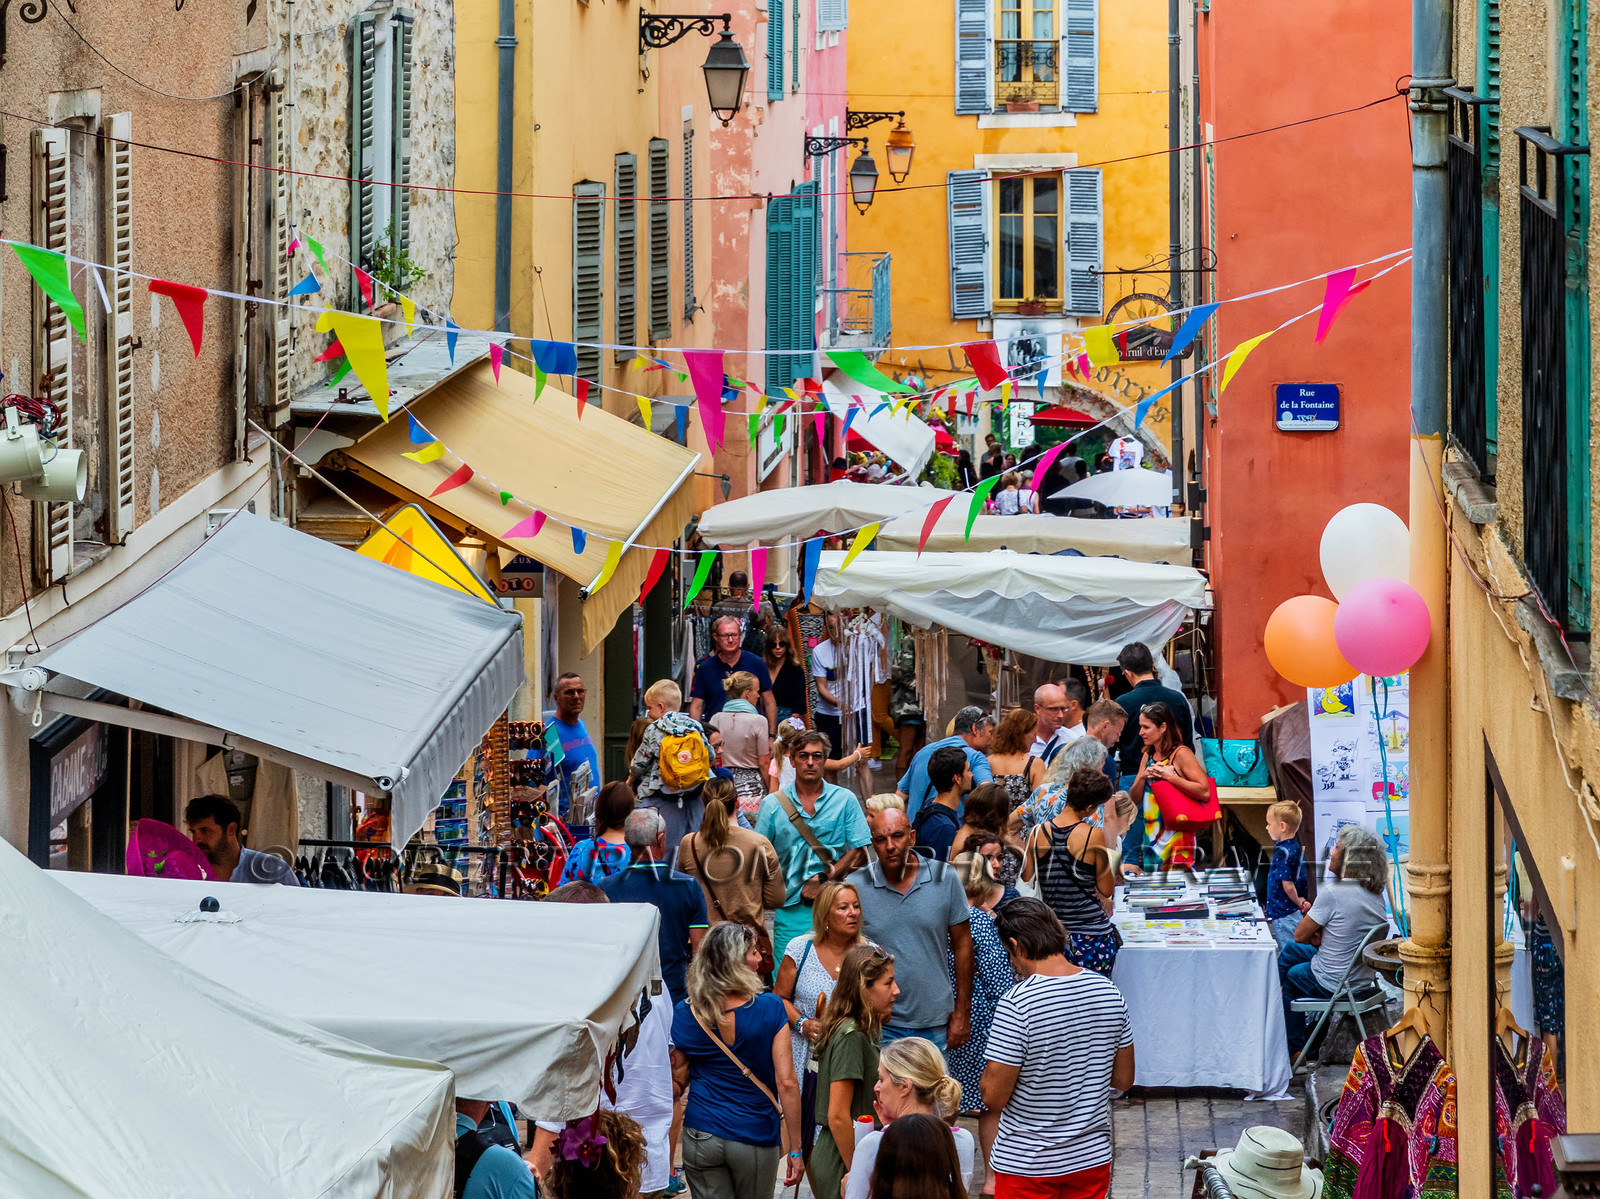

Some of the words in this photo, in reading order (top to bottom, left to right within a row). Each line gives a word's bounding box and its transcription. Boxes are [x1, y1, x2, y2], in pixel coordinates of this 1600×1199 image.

[1299, 388, 1316, 397] Rue
[1279, 400, 1290, 409] de
[1291, 400, 1299, 409] la
[1300, 400, 1335, 409] Fontaine
